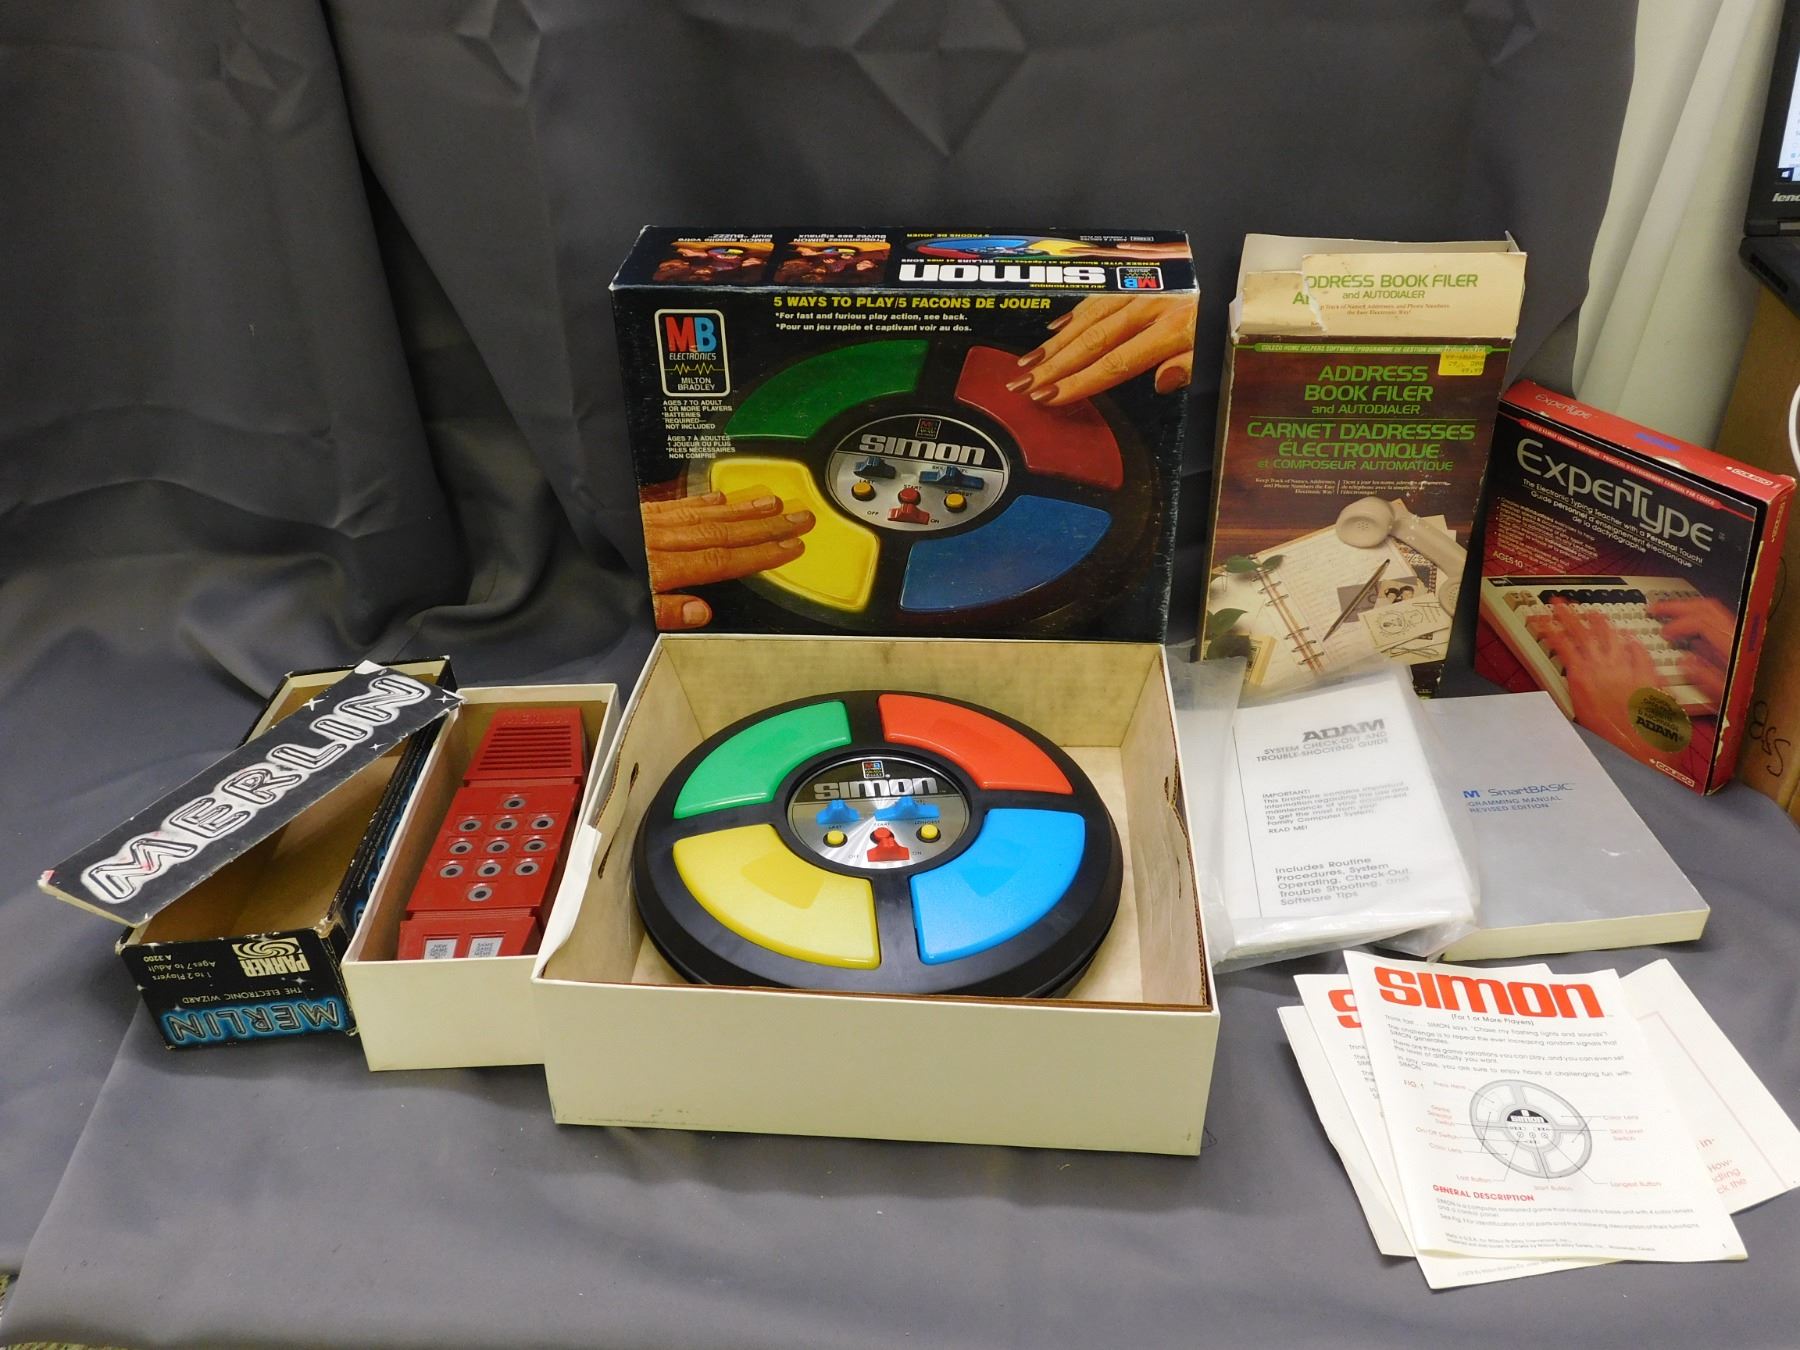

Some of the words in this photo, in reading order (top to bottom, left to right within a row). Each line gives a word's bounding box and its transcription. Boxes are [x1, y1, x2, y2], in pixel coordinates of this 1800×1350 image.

[1124, 277, 1156, 288] MB
[1306, 275, 1374, 288] DDRESS
[1380, 274, 1429, 288] BOOK
[1432, 274, 1478, 287] FILER
[1342, 290, 1360, 299] and
[1362, 290, 1425, 299] AUTODIALER
[774, 297, 782, 307] 5
[787, 297, 828, 307] WAYS
[831, 297, 852, 307] TO
[975, 298, 994, 309] DE
[1000, 298, 1051, 309] JOUER
[796, 312, 814, 320] fast
[869, 313, 888, 321] play
[890, 313, 921, 322] action,
[943, 313, 968, 321] back.
[665, 316, 717, 352] MB
[816, 324, 830, 332] jeu
[833, 324, 862, 332] rapide
[876, 324, 917, 332] captivant
[919, 324, 936, 332] voir
[953, 324, 972, 332] dos.
[669, 352, 717, 361] ELECTRONICS
[1318, 366, 1428, 381] ADDRESS
[681, 377, 712, 385] MILTON
[677, 384, 715, 392] BRADLEY
[1304, 385, 1369, 401] BOOK
[1372, 386, 1433, 402] FILER
[1312, 404, 1335, 414] and
[1338, 404, 1420, 415] AUTODIALER
[1247, 422, 1336, 439] CARNET
[1340, 424, 1476, 440] D'ADRESSES
[1257, 461, 1268, 469] et
[1273, 460, 1356, 470] COMPOSEUR
[1363, 461, 1454, 471] AUTOMATIQUE
[1531, 490, 1552, 504] Guide
[1553, 500, 1587, 519] personnel
[1523, 479, 1535, 488] The
[1536, 484, 1569, 502] Electronic
[1571, 498, 1593, 514] Typing
[1595, 508, 1622, 525] Teacher
[1623, 523, 1638, 534] with
[1647, 533, 1678, 551] Personal
[1679, 548, 1703, 563] Touch!
[1493, 550, 1514, 564] AGES
[1514, 560, 1523, 568] 10
[1303, 719, 1385, 742] ADAM
[1636, 716, 1680, 742] ADAM
[1264, 745, 1299, 754] SYSTEM
[1303, 737, 1360, 750] CHECK-OUT
[1365, 731, 1387, 740] AND
[1256, 743, 1354, 762] TROUBLE-SHOOTING
[1358, 738, 1388, 748] GUIDE
[83, 674, 430, 904] MERLIN
[1262, 788, 1311, 798] IMPORTANT!
[1488, 783, 1573, 797] SmartBASIC
[1522, 795, 1563, 803] MANUAL
[1512, 803, 1549, 811] EDITION
[1275, 863, 1324, 874] Includes
[1328, 857, 1372, 868] Routine
[1277, 869, 1345, 882] Procedures,
[1349, 863, 1390, 874] System
[1279, 887, 1321, 897] Trouble
[1280, 894, 1332, 906] Software
[1336, 891, 1358, 900] Tips
[148, 963, 172, 972] Adult
[194, 960, 216, 968] Ages
[239, 953, 310, 977] PARKER
[152, 971, 186, 981] Players
[224, 989, 281, 1001] ELECTRONIC
[285, 988, 303, 996] THE
[182, 994, 221, 1004] WIZARD
[167, 1001, 339, 1042] MERLIN
[1730, 1178, 1747, 1190] the
[1432, 1184, 1471, 1198] GENERAL
[1473, 1191, 1535, 1202] DESCRIPTION
